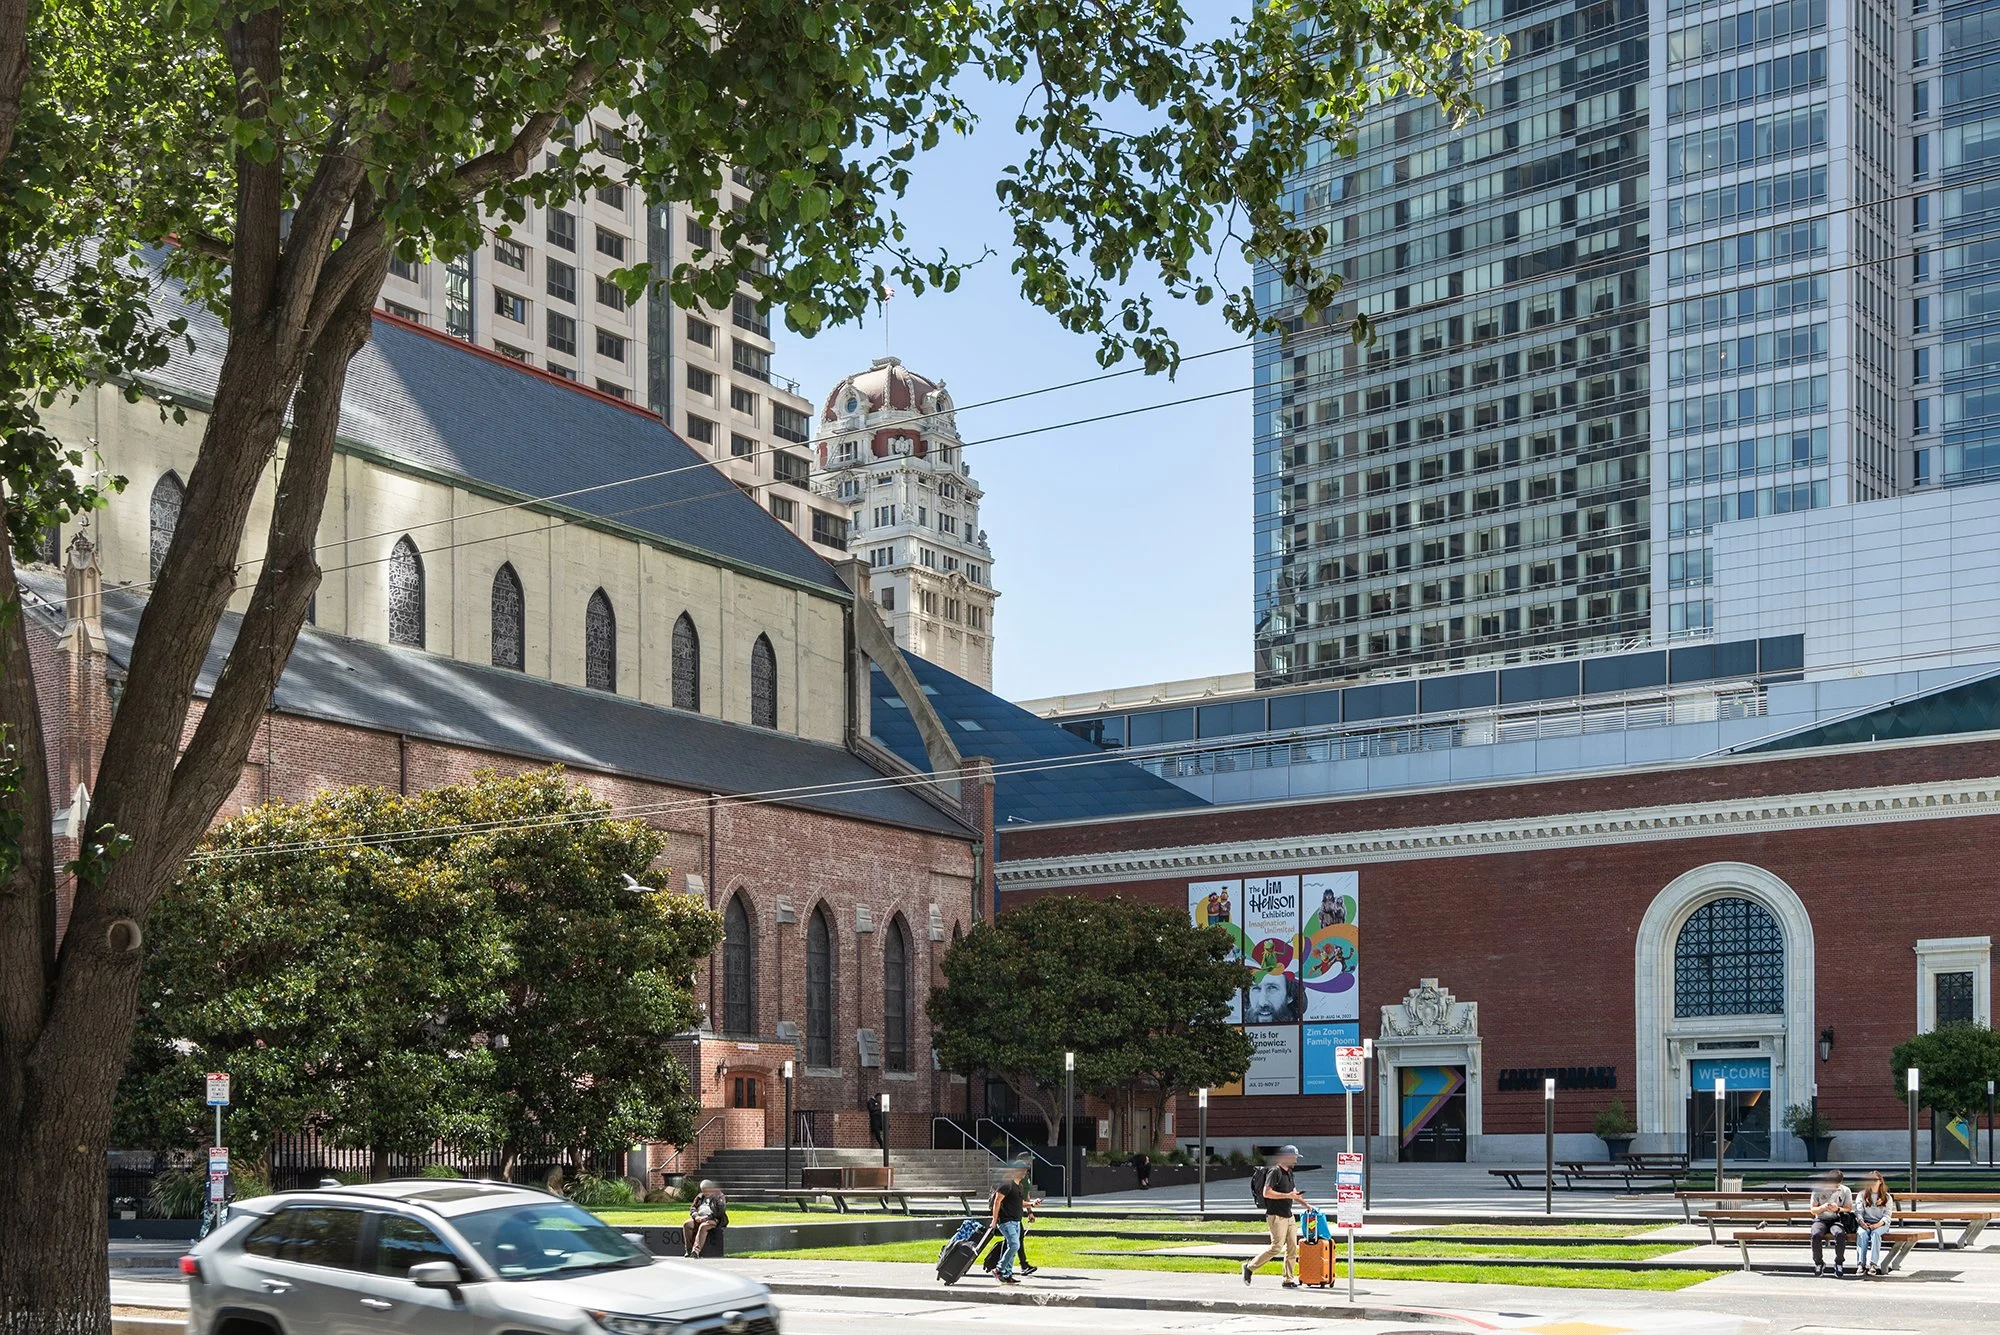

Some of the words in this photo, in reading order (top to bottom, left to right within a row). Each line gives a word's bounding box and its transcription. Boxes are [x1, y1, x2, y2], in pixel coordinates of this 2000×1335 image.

[1249, 885, 1260, 893] The
[1262, 910, 1294, 918] Exhibition
[1249, 920, 1286, 928] Imagination
[1248, 1031, 1258, 1039] Oz
[1307, 1028, 1321, 1036] Zim
[1323, 1028, 1344, 1036] Zoom
[1307, 1038, 1331, 1046] Family
[1699, 1067, 1769, 1079] WELCOME
